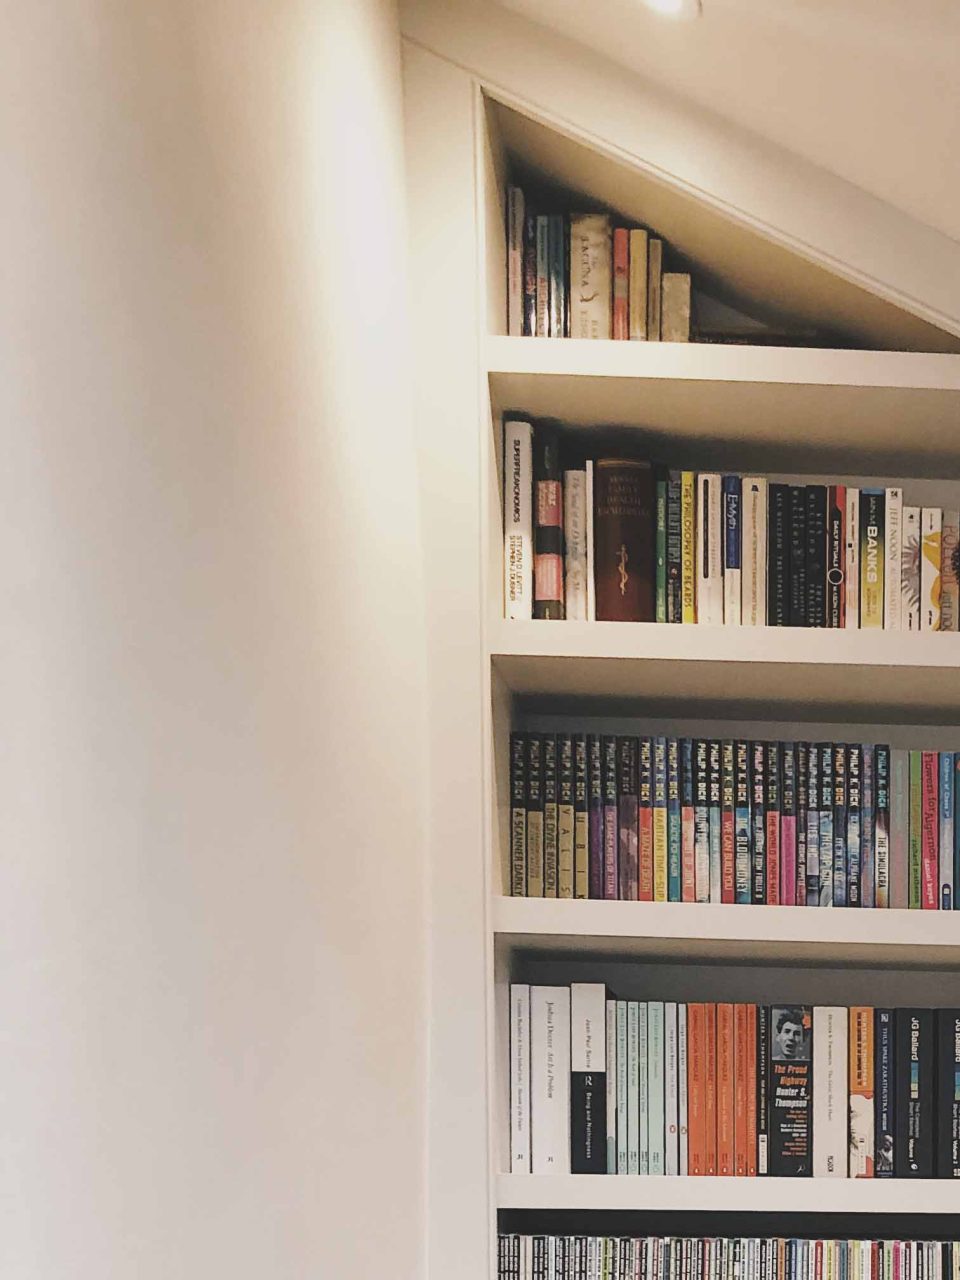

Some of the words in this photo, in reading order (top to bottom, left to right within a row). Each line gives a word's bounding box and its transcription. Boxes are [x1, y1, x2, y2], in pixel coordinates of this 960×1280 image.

[513, 440, 521, 523] SUPERFREAKONOMICS
[684, 483, 692, 499] THE
[684, 502, 692, 555] PHILOSOPHY
[889, 507, 898, 527] JEFF
[889, 530, 898, 561] NOON
[684, 559, 692, 571] OF
[684, 575, 692, 608] BEARDS
[924, 752, 935, 794] Flowers
[878, 790, 887, 808] DICK
[928, 796, 937, 812] for
[514, 820, 524, 862] SCANNER
[878, 837, 887, 849] THE
[514, 864, 524, 896] DARKLY
[878, 851, 887, 889] SIMULACRA
